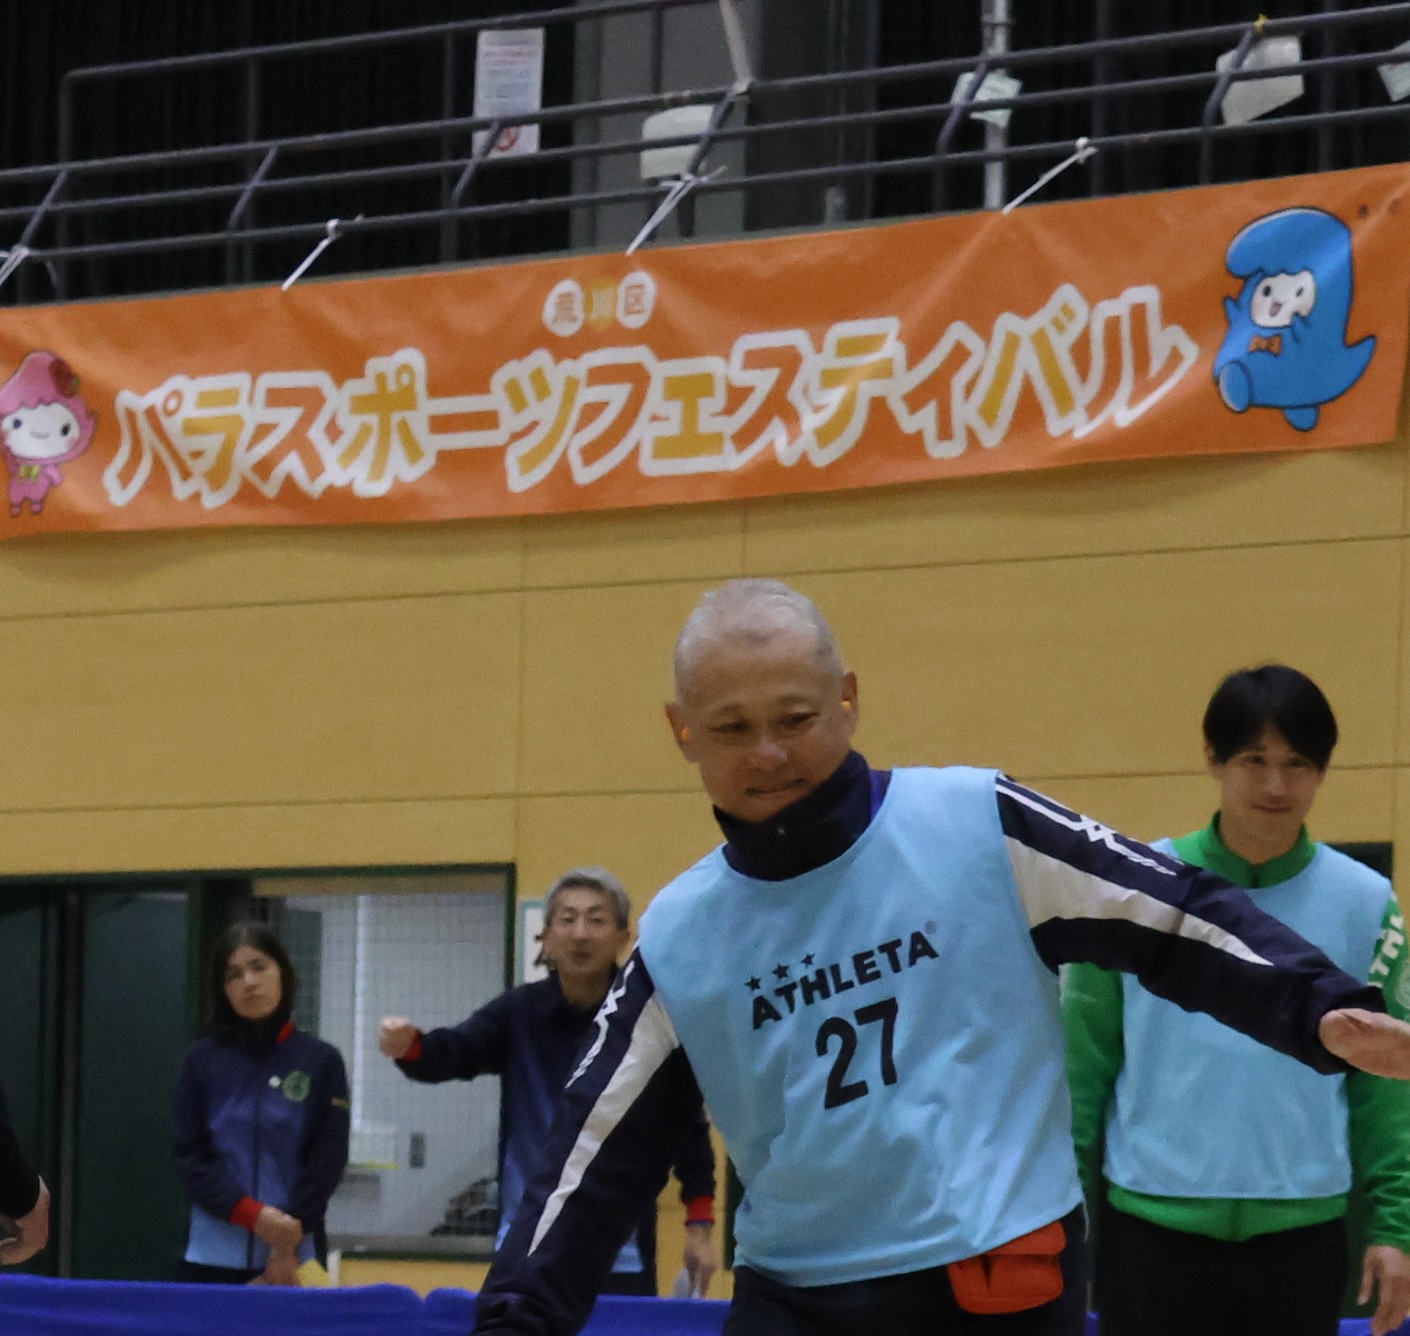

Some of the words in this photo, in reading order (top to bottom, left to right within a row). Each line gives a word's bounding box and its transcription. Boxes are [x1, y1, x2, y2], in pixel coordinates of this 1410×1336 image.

[104, 283, 1198, 507] パラスポーツフェスティバル
[752, 931, 940, 1030] ATHLETA
[815, 997, 898, 1110] 27
